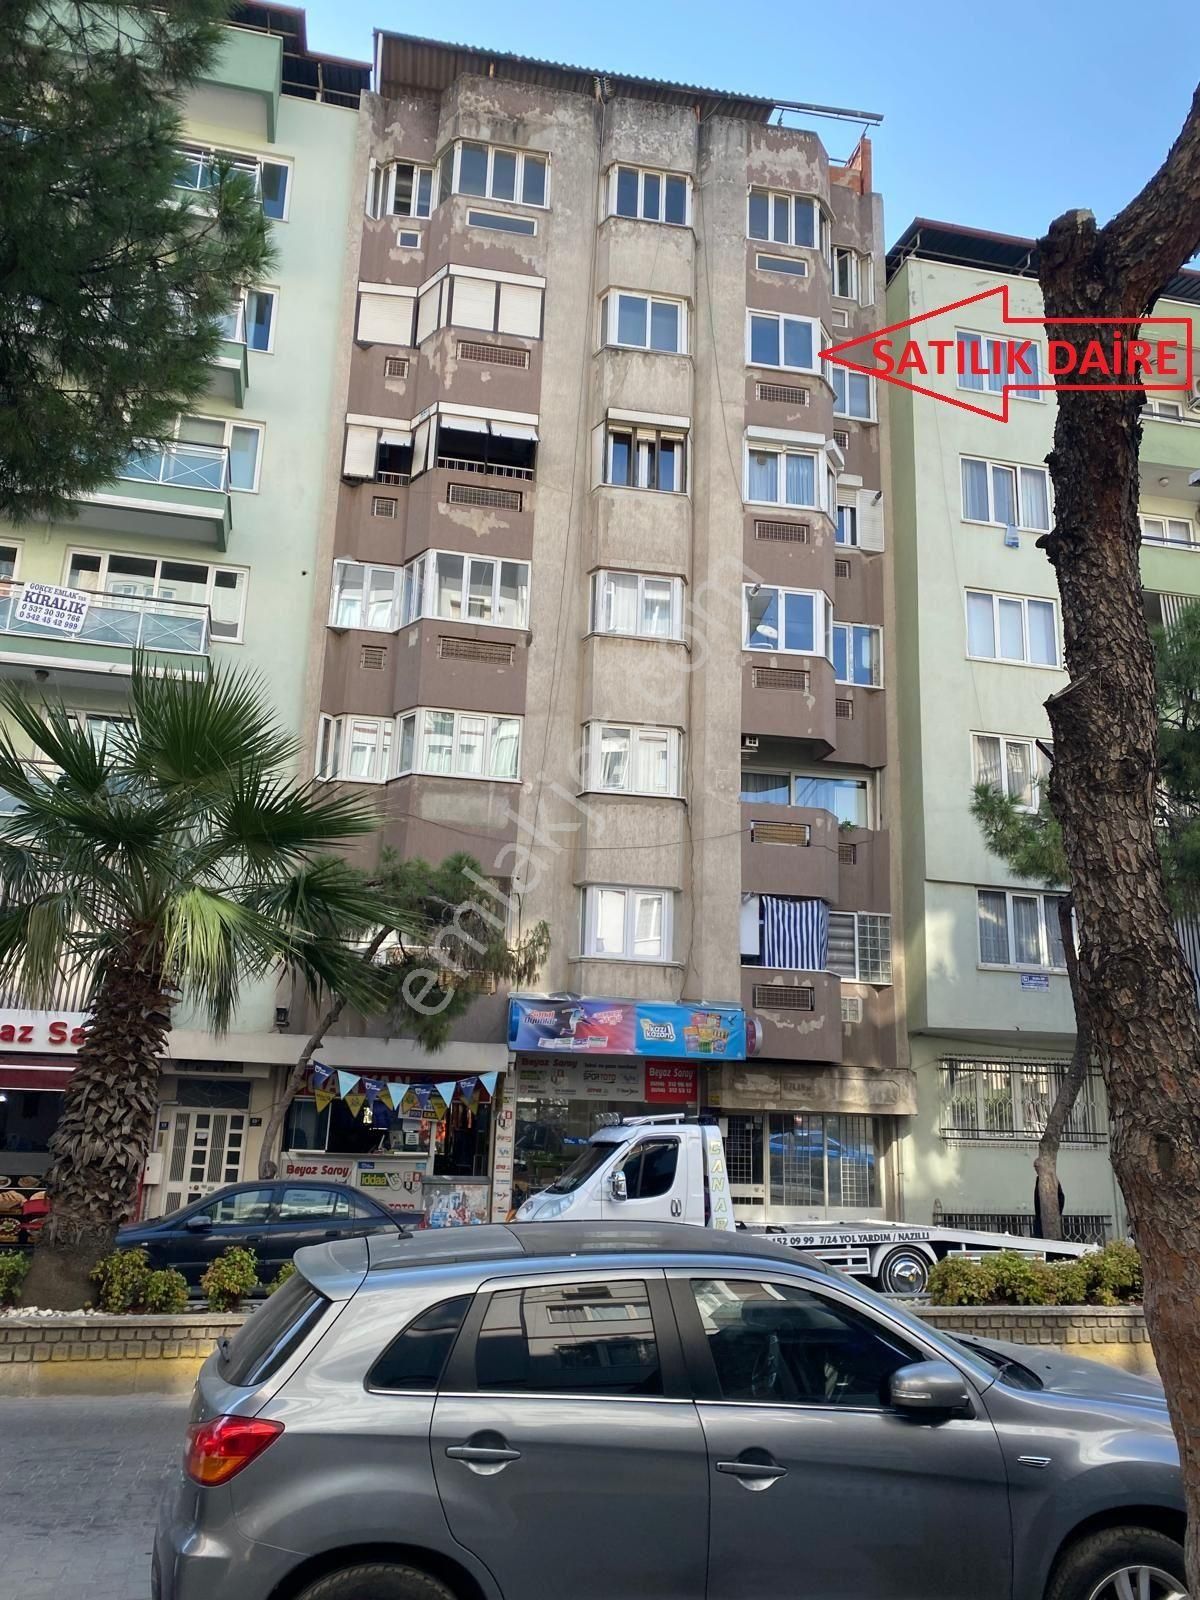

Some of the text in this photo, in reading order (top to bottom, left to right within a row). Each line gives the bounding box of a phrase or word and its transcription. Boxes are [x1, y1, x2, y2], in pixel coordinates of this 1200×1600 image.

[19, 610, 25, 618] 0
[28, 604, 43, 614] 537
[44, 608, 54, 616] 30
[55, 610, 65, 619] 30
[286, 1164, 318, 1177] Beyaz
[320, 1165, 350, 1178] Saray
[361, 1173, 387, 1185] iddaa
[772, 1236, 788, 1245] 52
[790, 1236, 801, 1245] 09
[803, 1236, 815, 1245] 99
[819, 1235, 838, 1244] 7/24
[839, 1234, 856, 1244] YOL
[857, 1233, 891, 1243] YARDIM
